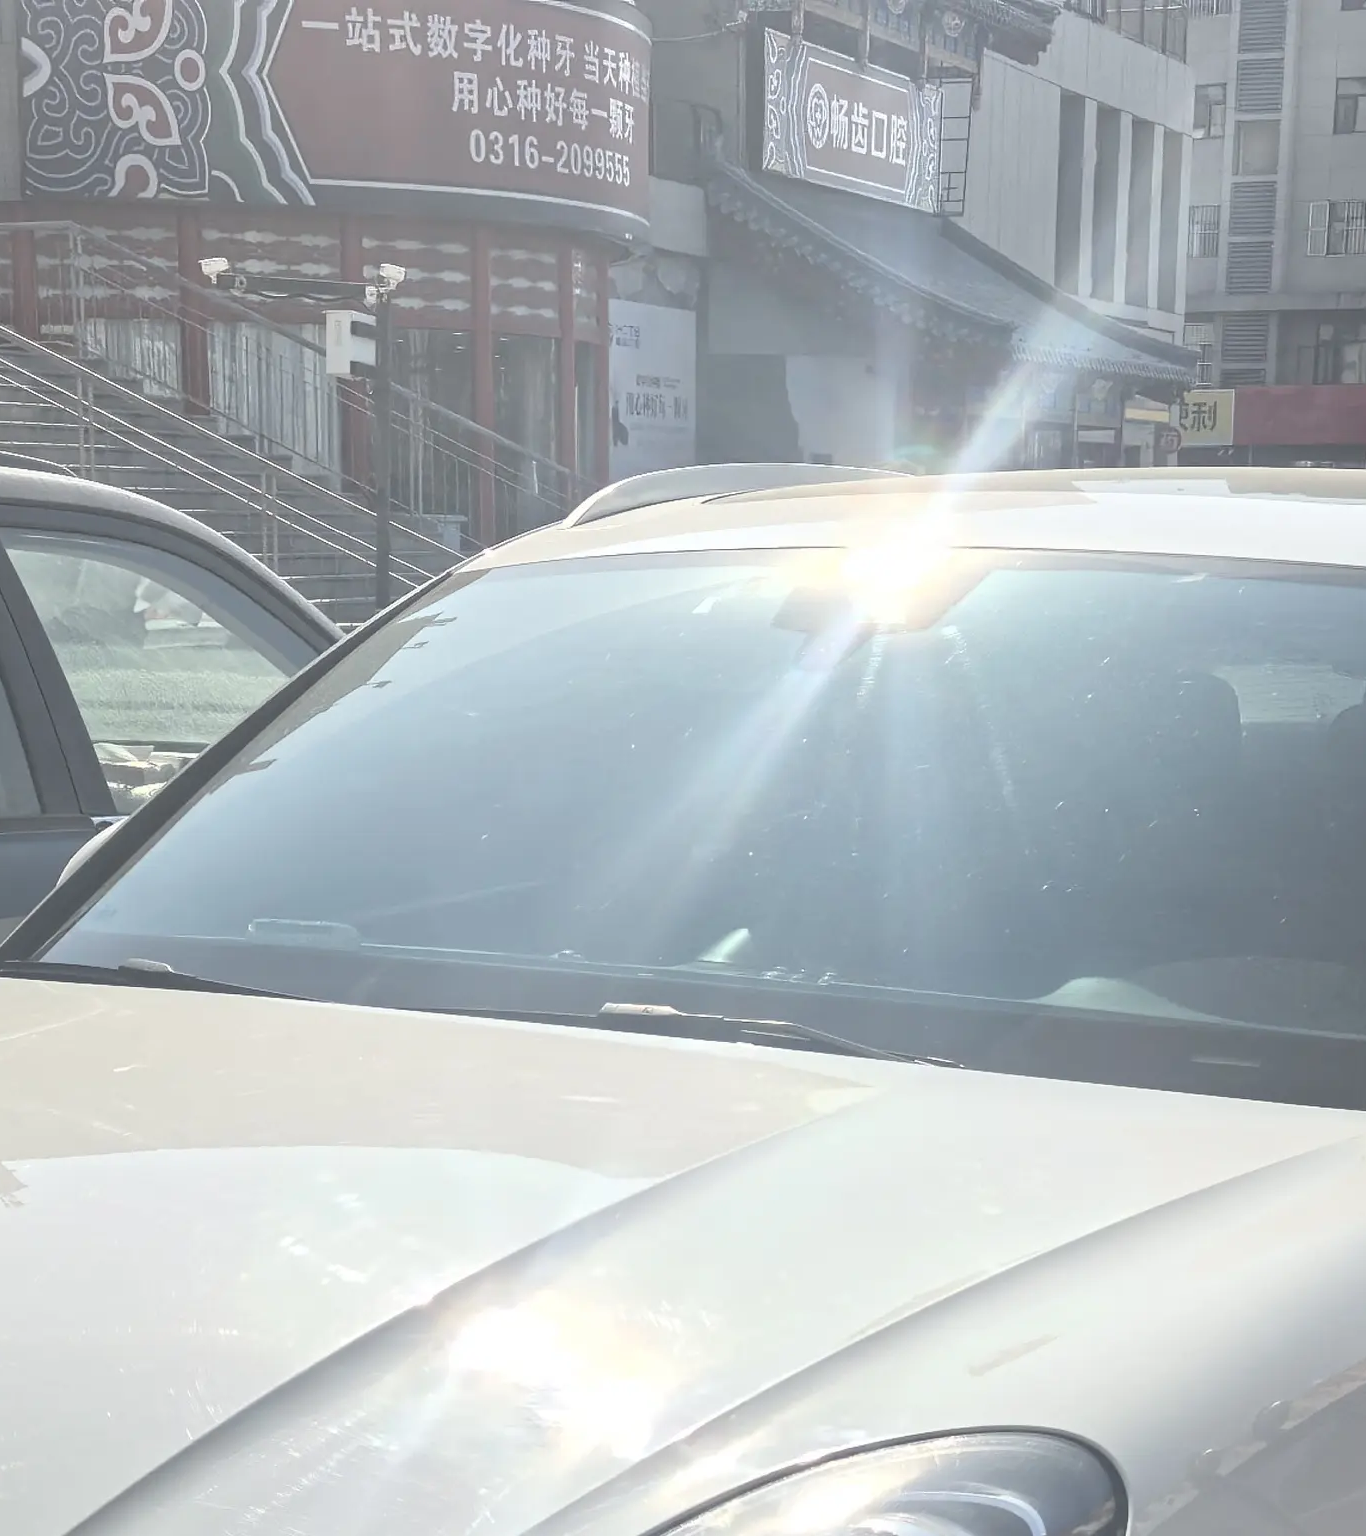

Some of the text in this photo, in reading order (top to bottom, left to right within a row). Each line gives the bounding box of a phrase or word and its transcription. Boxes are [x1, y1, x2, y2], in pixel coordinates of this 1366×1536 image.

[301, 7, 575, 77] 一站式数字化种牙
[451, 71, 635, 145] 用心种好每一颗牙
[830, 94, 908, 167] 畅齿口腔
[469, 129, 631, 187] 0316-2099555
